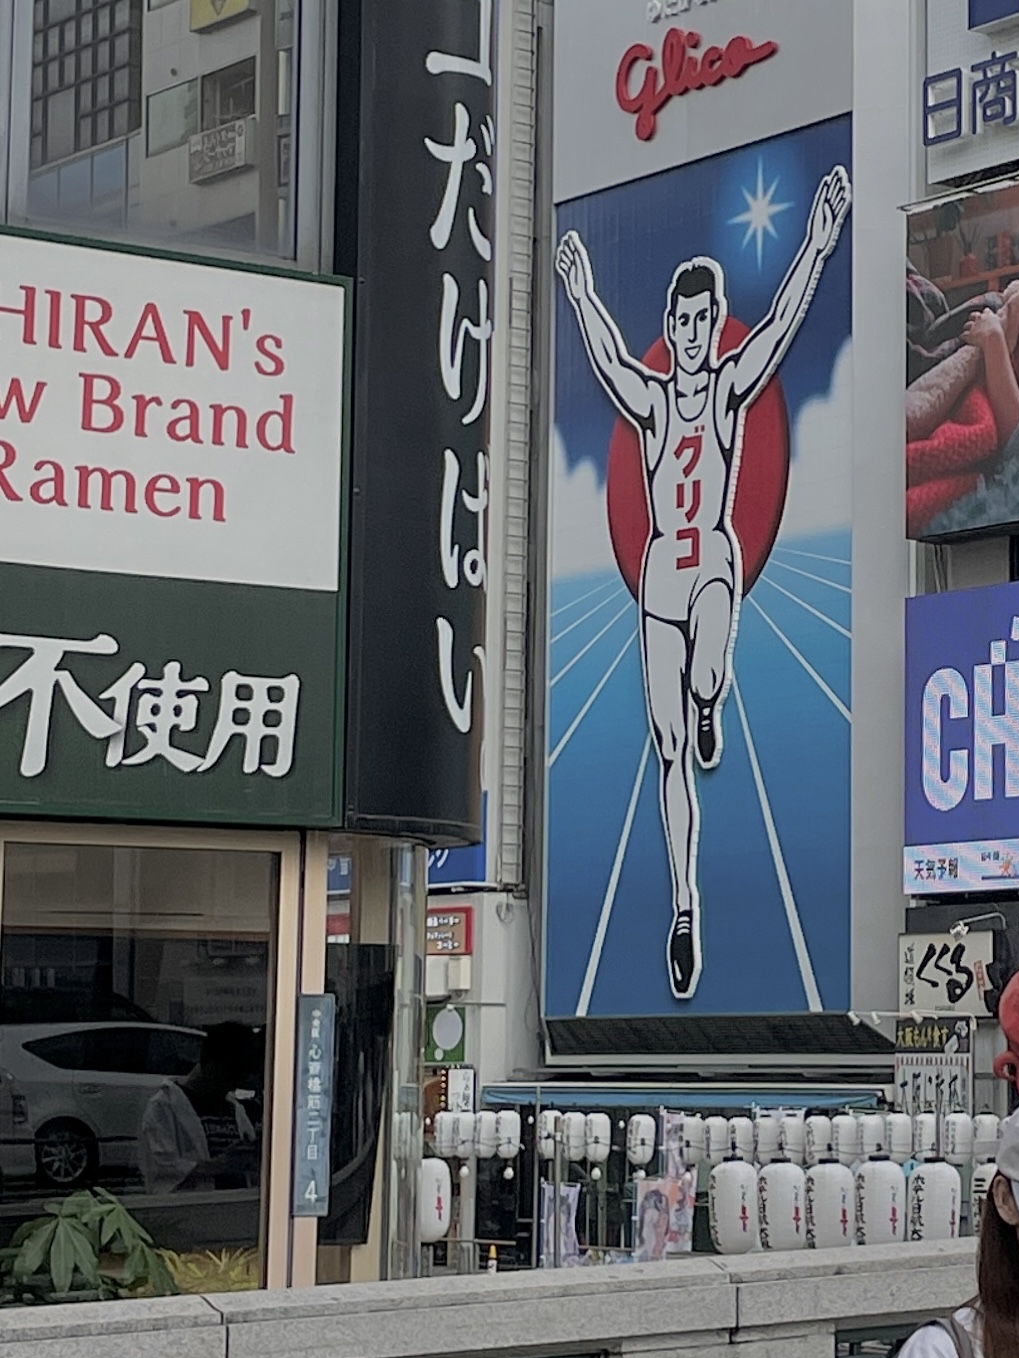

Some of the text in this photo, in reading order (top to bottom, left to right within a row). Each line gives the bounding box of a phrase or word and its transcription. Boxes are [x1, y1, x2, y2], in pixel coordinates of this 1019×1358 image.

[616, 28, 778, 141] Glico
[79, 373, 296, 454] Brand
[674, 425, 706, 570] グリコ
[0, 632, 300, 779] 不使用
[913, 857, 959, 881] 天気予報
[916, 943, 974, 1004] くくる
[304, 1179, 318, 1203] 4
